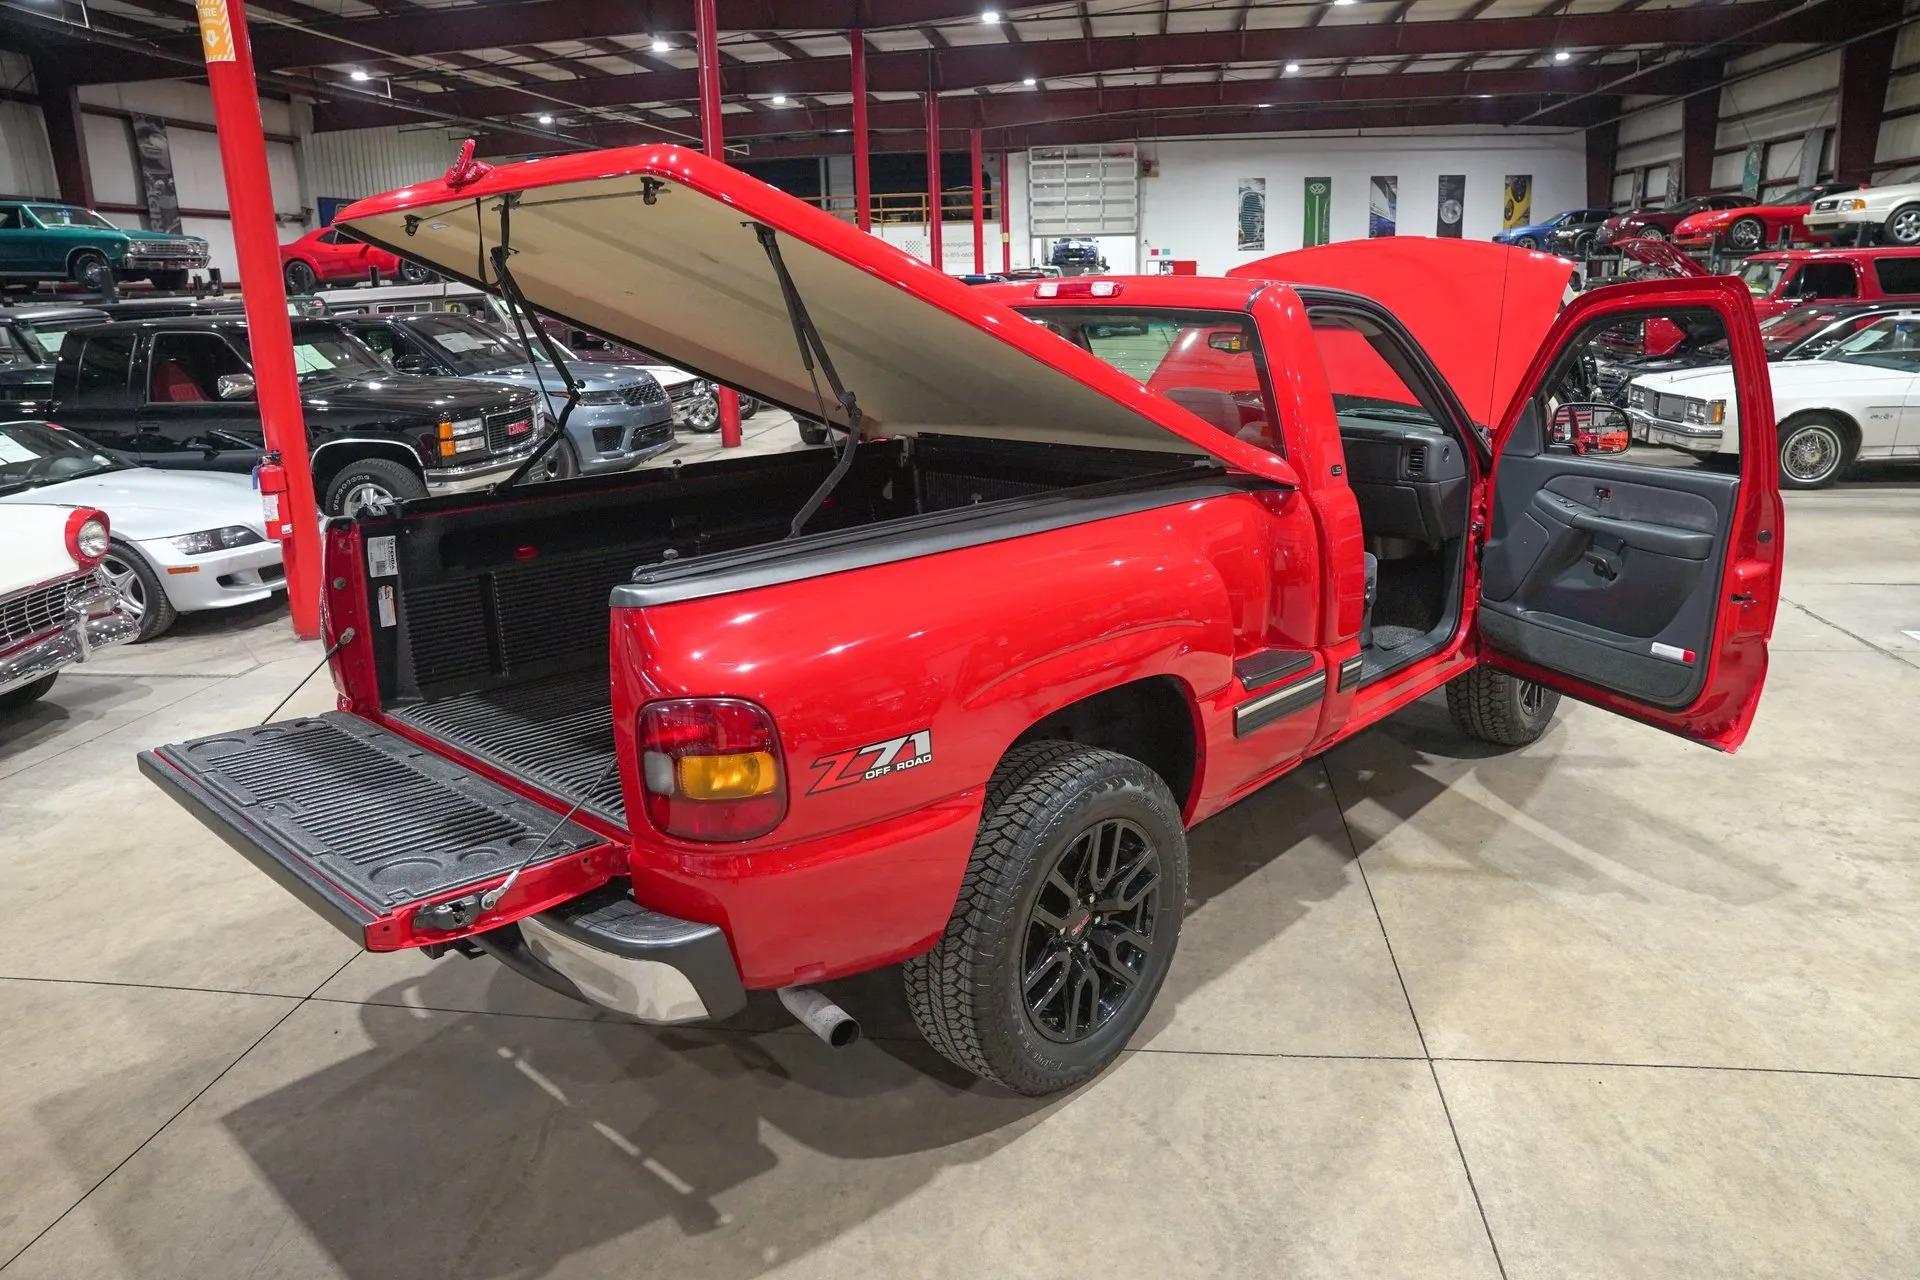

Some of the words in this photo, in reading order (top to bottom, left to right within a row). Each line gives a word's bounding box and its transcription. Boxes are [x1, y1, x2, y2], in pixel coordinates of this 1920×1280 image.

[805, 728, 931, 796] Z71
[865, 766, 891, 780] OFF
[897, 754, 932, 771] ROAD
